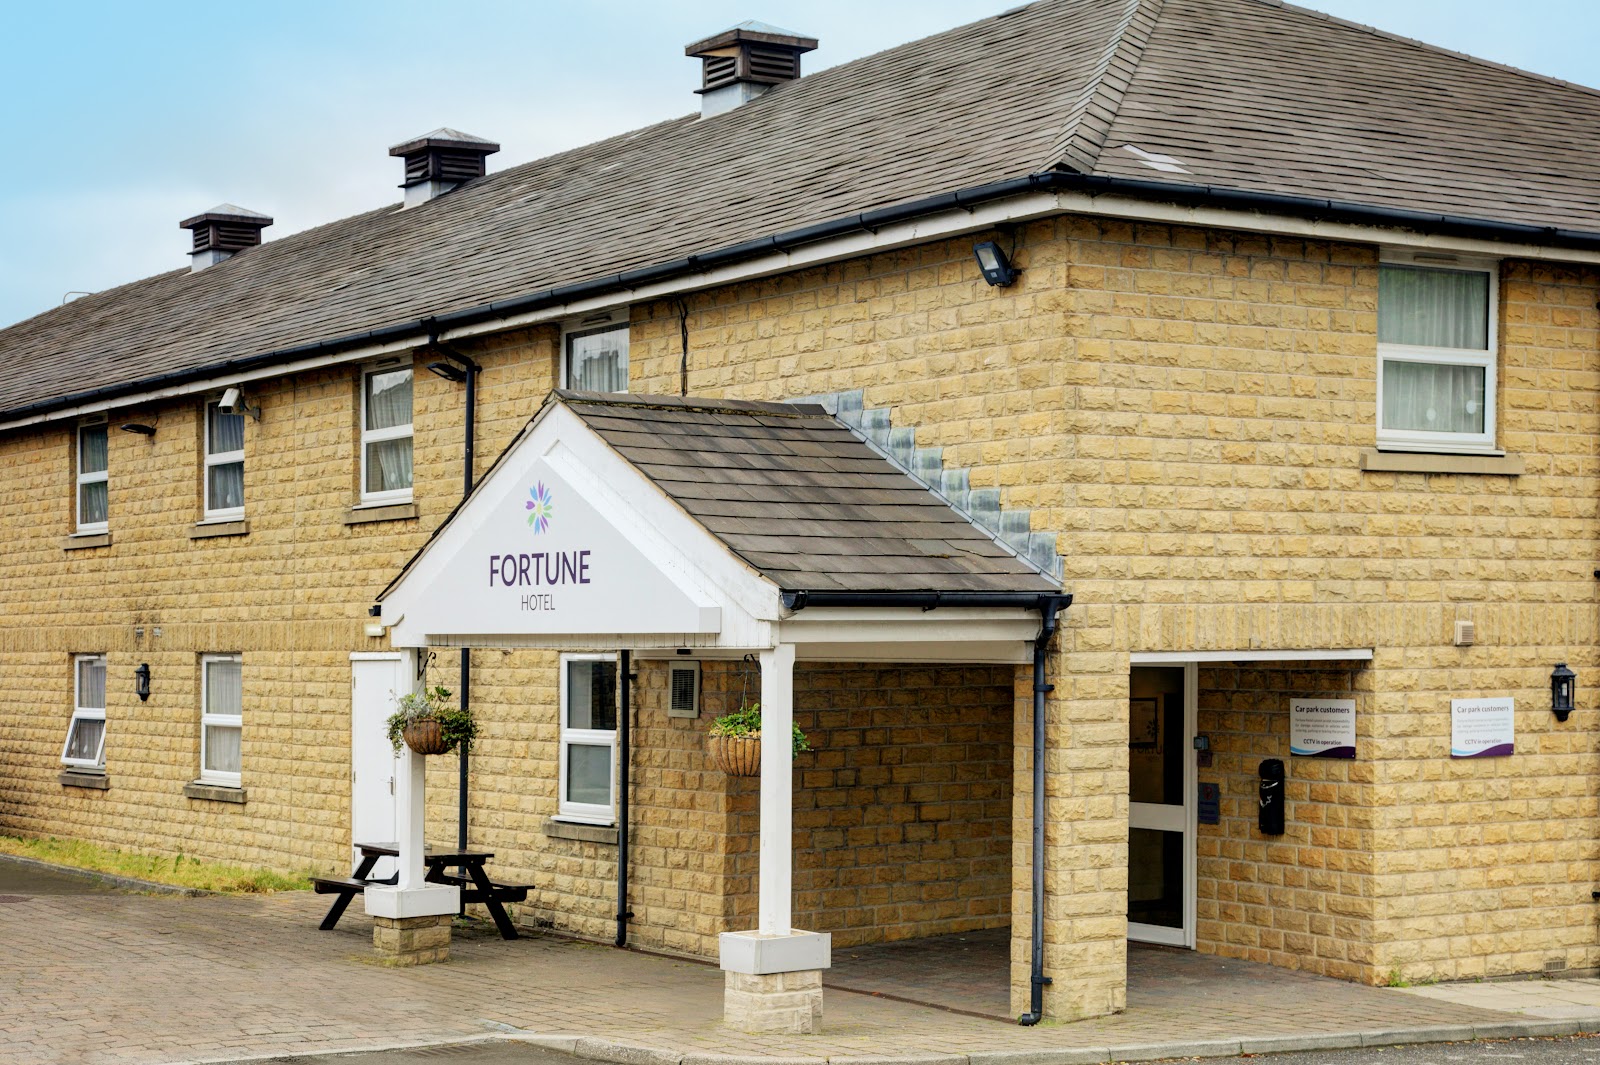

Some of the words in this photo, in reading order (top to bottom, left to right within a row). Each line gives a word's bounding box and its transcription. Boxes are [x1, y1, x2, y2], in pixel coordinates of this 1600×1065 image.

[490, 550, 591, 587] FORTUNE
[521, 594, 556, 611] HOTEL
[1295, 705, 1305, 713] Car
[1306, 706, 1319, 714] park
[1320, 706, 1350, 714] customers
[1468, 705, 1481, 714] park
[1481, 705, 1509, 713] customers
